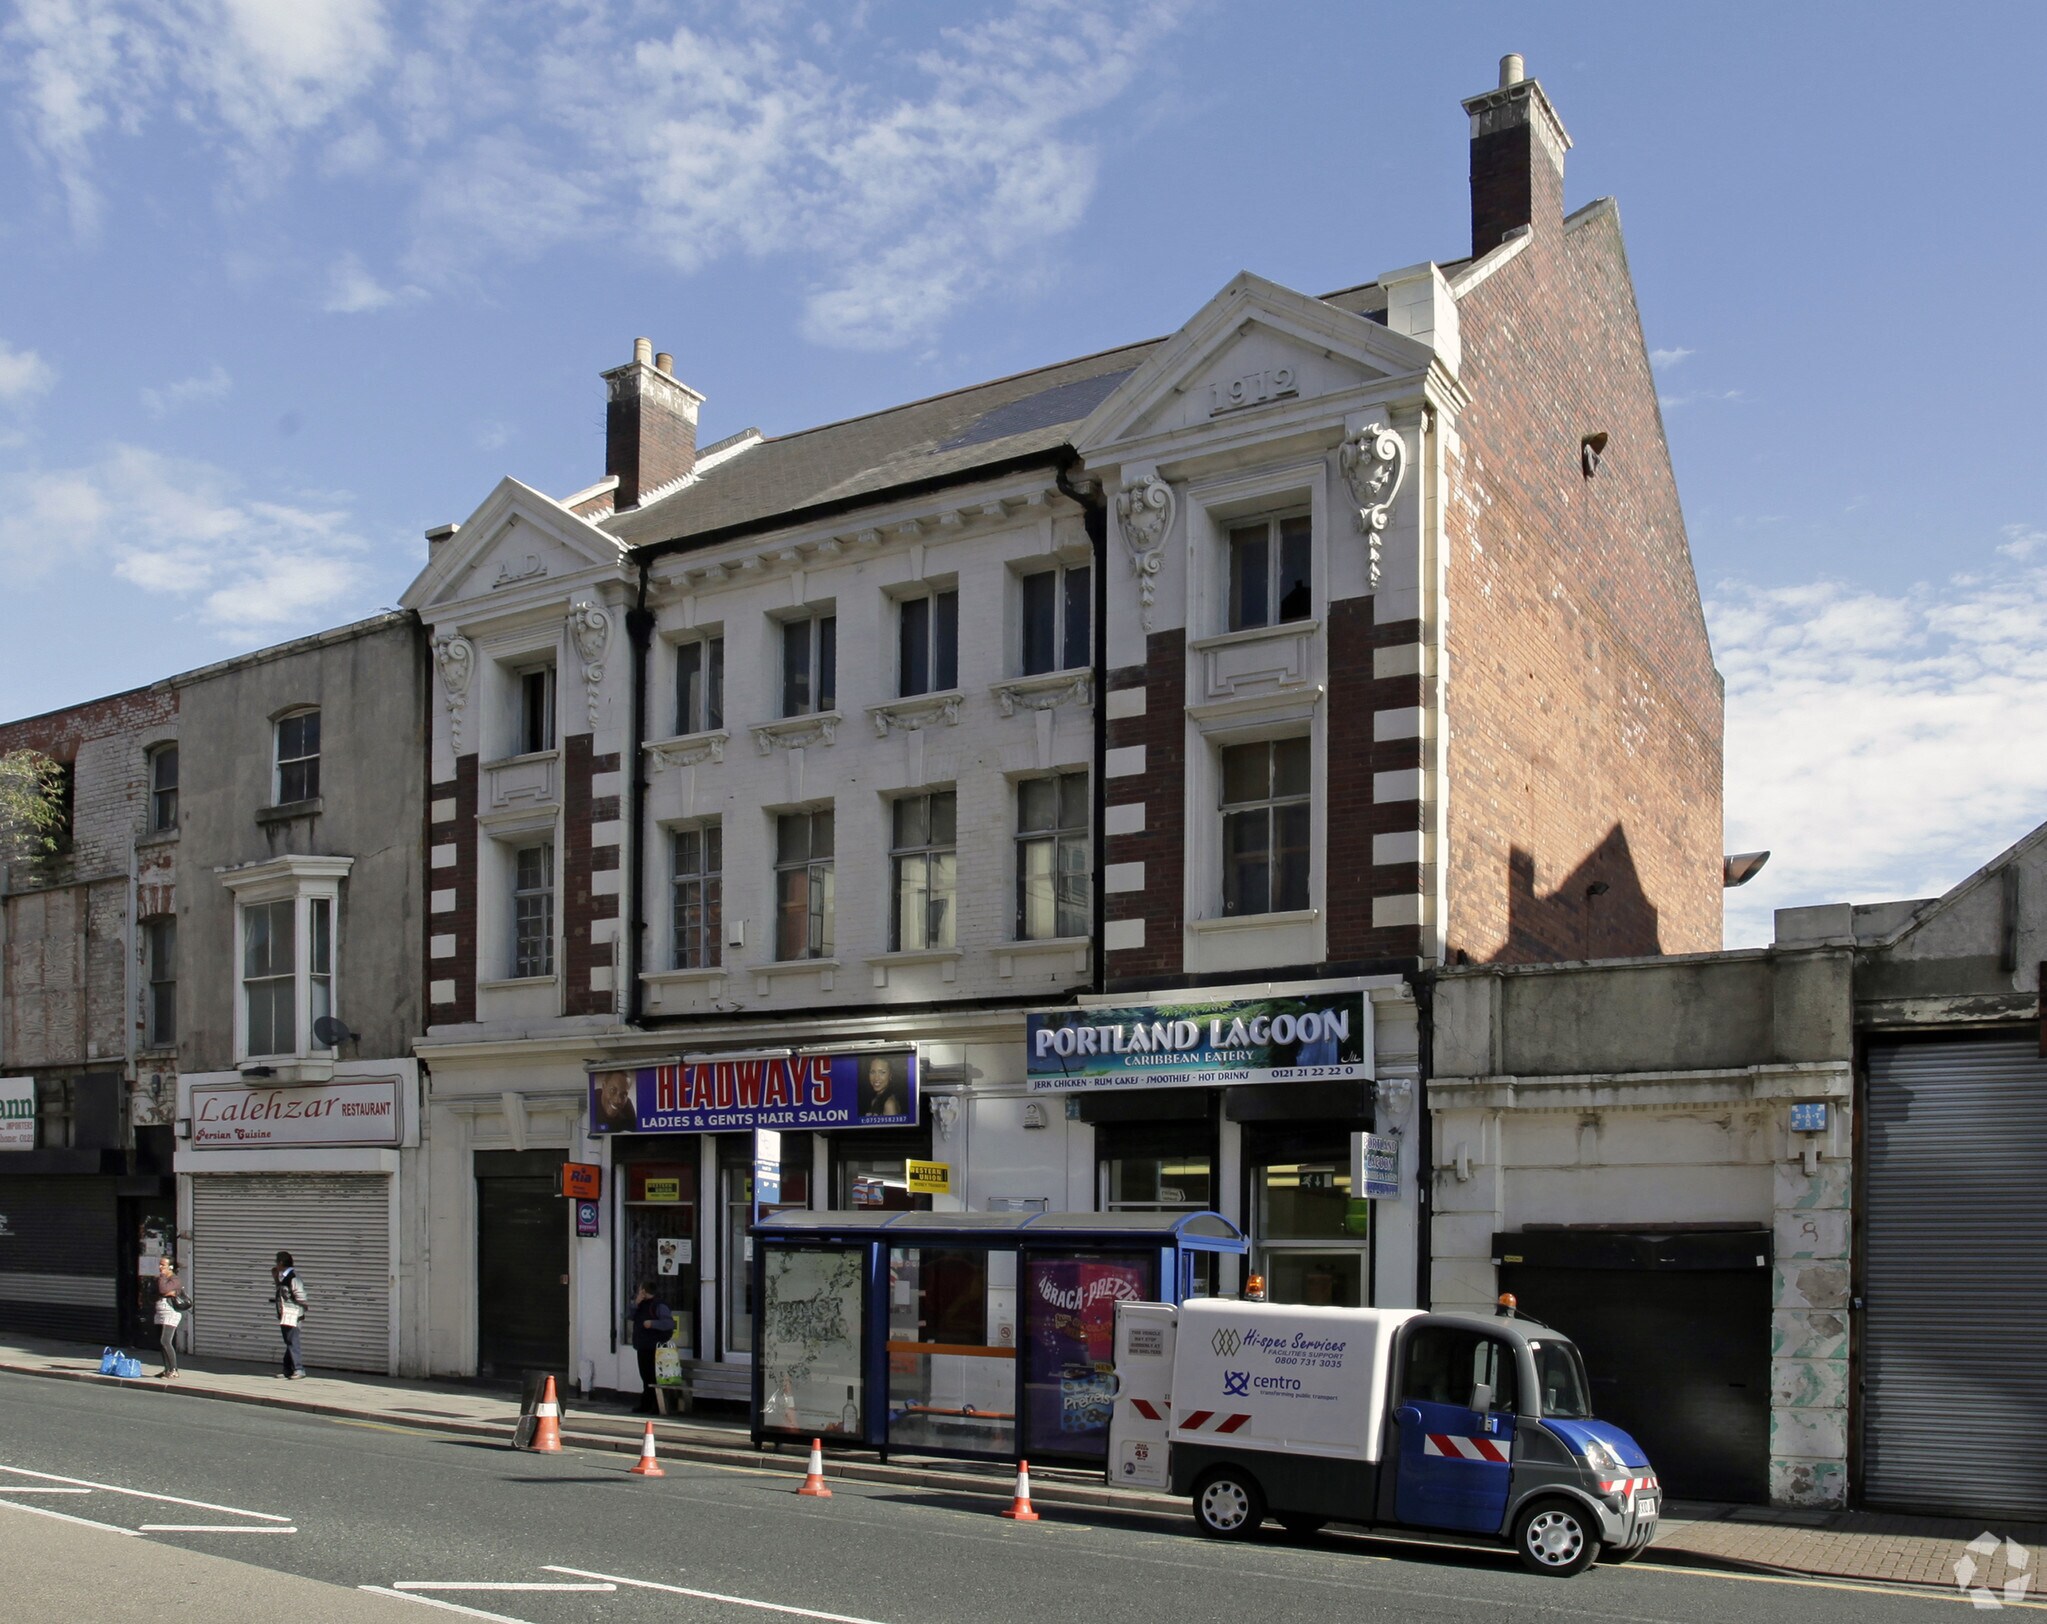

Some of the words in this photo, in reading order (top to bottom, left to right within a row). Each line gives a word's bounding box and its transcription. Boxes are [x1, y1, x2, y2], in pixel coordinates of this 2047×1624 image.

[1209, 366, 1297, 410] 1912
[1035, 1020, 1200, 1058] PORTLAND
[1209, 1009, 1350, 1050] LAGOON
[1124, 1053, 1200, 1067] CARIBBEAN
[1205, 1050, 1254, 1063] EATERY
[1033, 1079, 1052, 1090] JERK
[1054, 1078, 1087, 1088] CHICKEN
[1094, 1077, 1113, 1086] RUM
[1115, 1076, 1139, 1085] CAKES
[1146, 1074, 1190, 1084] SMOOTHIES
[1198, 1072, 1215, 1082] HOT
[1218, 1071, 1249, 1080] DRINKS
[1271, 1069, 1294, 1078] 0121
[1297, 1069, 1308, 1077] 21
[1312, 1068, 1324, 1076] 22
[1328, 1067, 1341, 1076] 22
[1345, 1066, 1354, 1075] 0
[656, 1055, 832, 1112] HEADWAYS
[197, 1091, 341, 1122] Lalehzar
[341, 1102, 392, 1117] RESTAURANT
[641, 1116, 691, 1129] LADIES
[693, 1115, 705, 1127] &
[709, 1114, 753, 1126] GENTS
[758, 1112, 794, 1124] HAIR
[799, 1109, 849, 1123] SALON
[195, 1128, 231, 1141] Persian
[235, 1128, 271, 1140] Cuisine
[1363, 1135, 1398, 1153] PORTLAND
[571, 1168, 592, 1183] Ria
[1243, 1328, 1287, 1354] Hi-spec
[1291, 1332, 1347, 1352] Services
[1268, 1349, 1307, 1358] FACILITIES
[1308, 1351, 1344, 1360] SUPPORT
[1274, 1356, 1298, 1366] 0800
[1300, 1358, 1316, 1367] 731
[1319, 1359, 1342, 1368] 3035
[1253, 1376, 1301, 1390] centro
[1064, 1392, 1111, 1410] Pretzels
[1260, 1390, 1295, 1399] transforming
[1312, 1393, 1338, 1401] transport
[1135, 1450, 1149, 1458] 45
